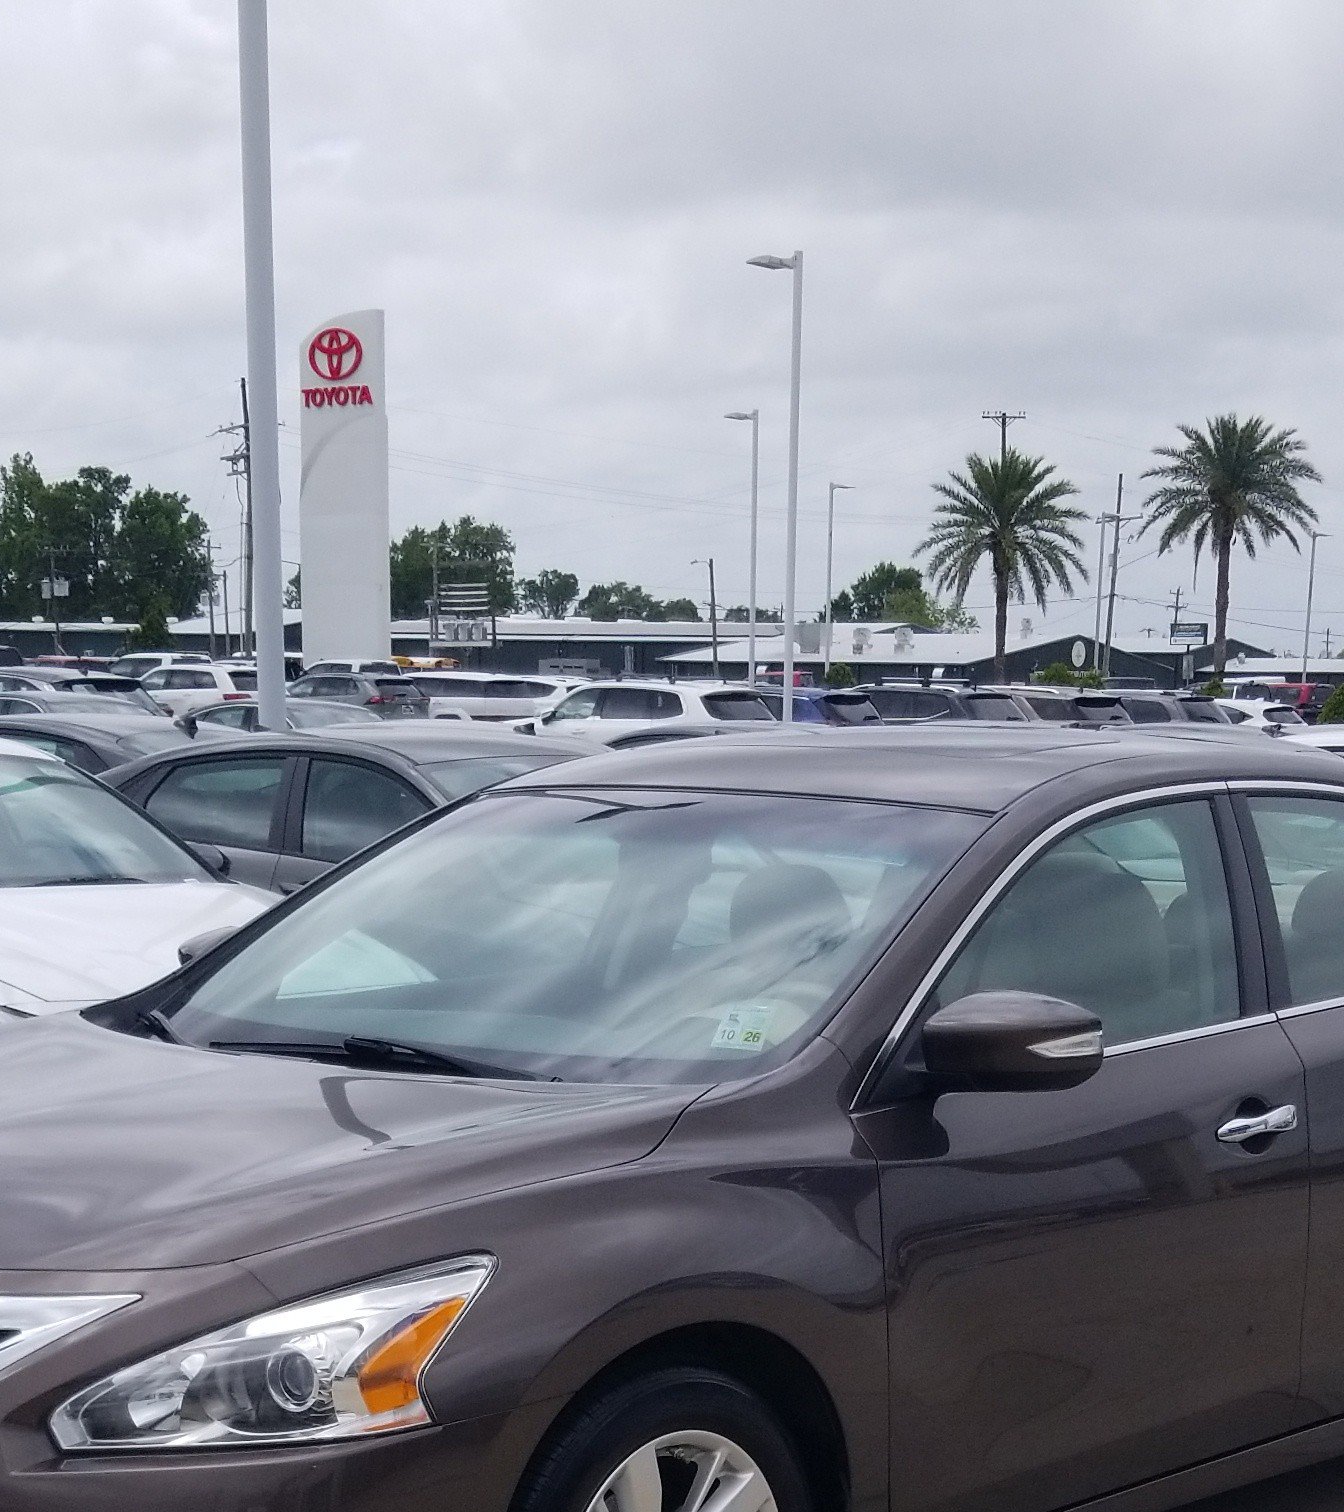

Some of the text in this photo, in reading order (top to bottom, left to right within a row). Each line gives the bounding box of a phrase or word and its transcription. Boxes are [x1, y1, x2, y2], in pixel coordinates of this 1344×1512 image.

[301, 385, 373, 408] TOYOTA
[721, 1030, 761, 1043] 10 26
